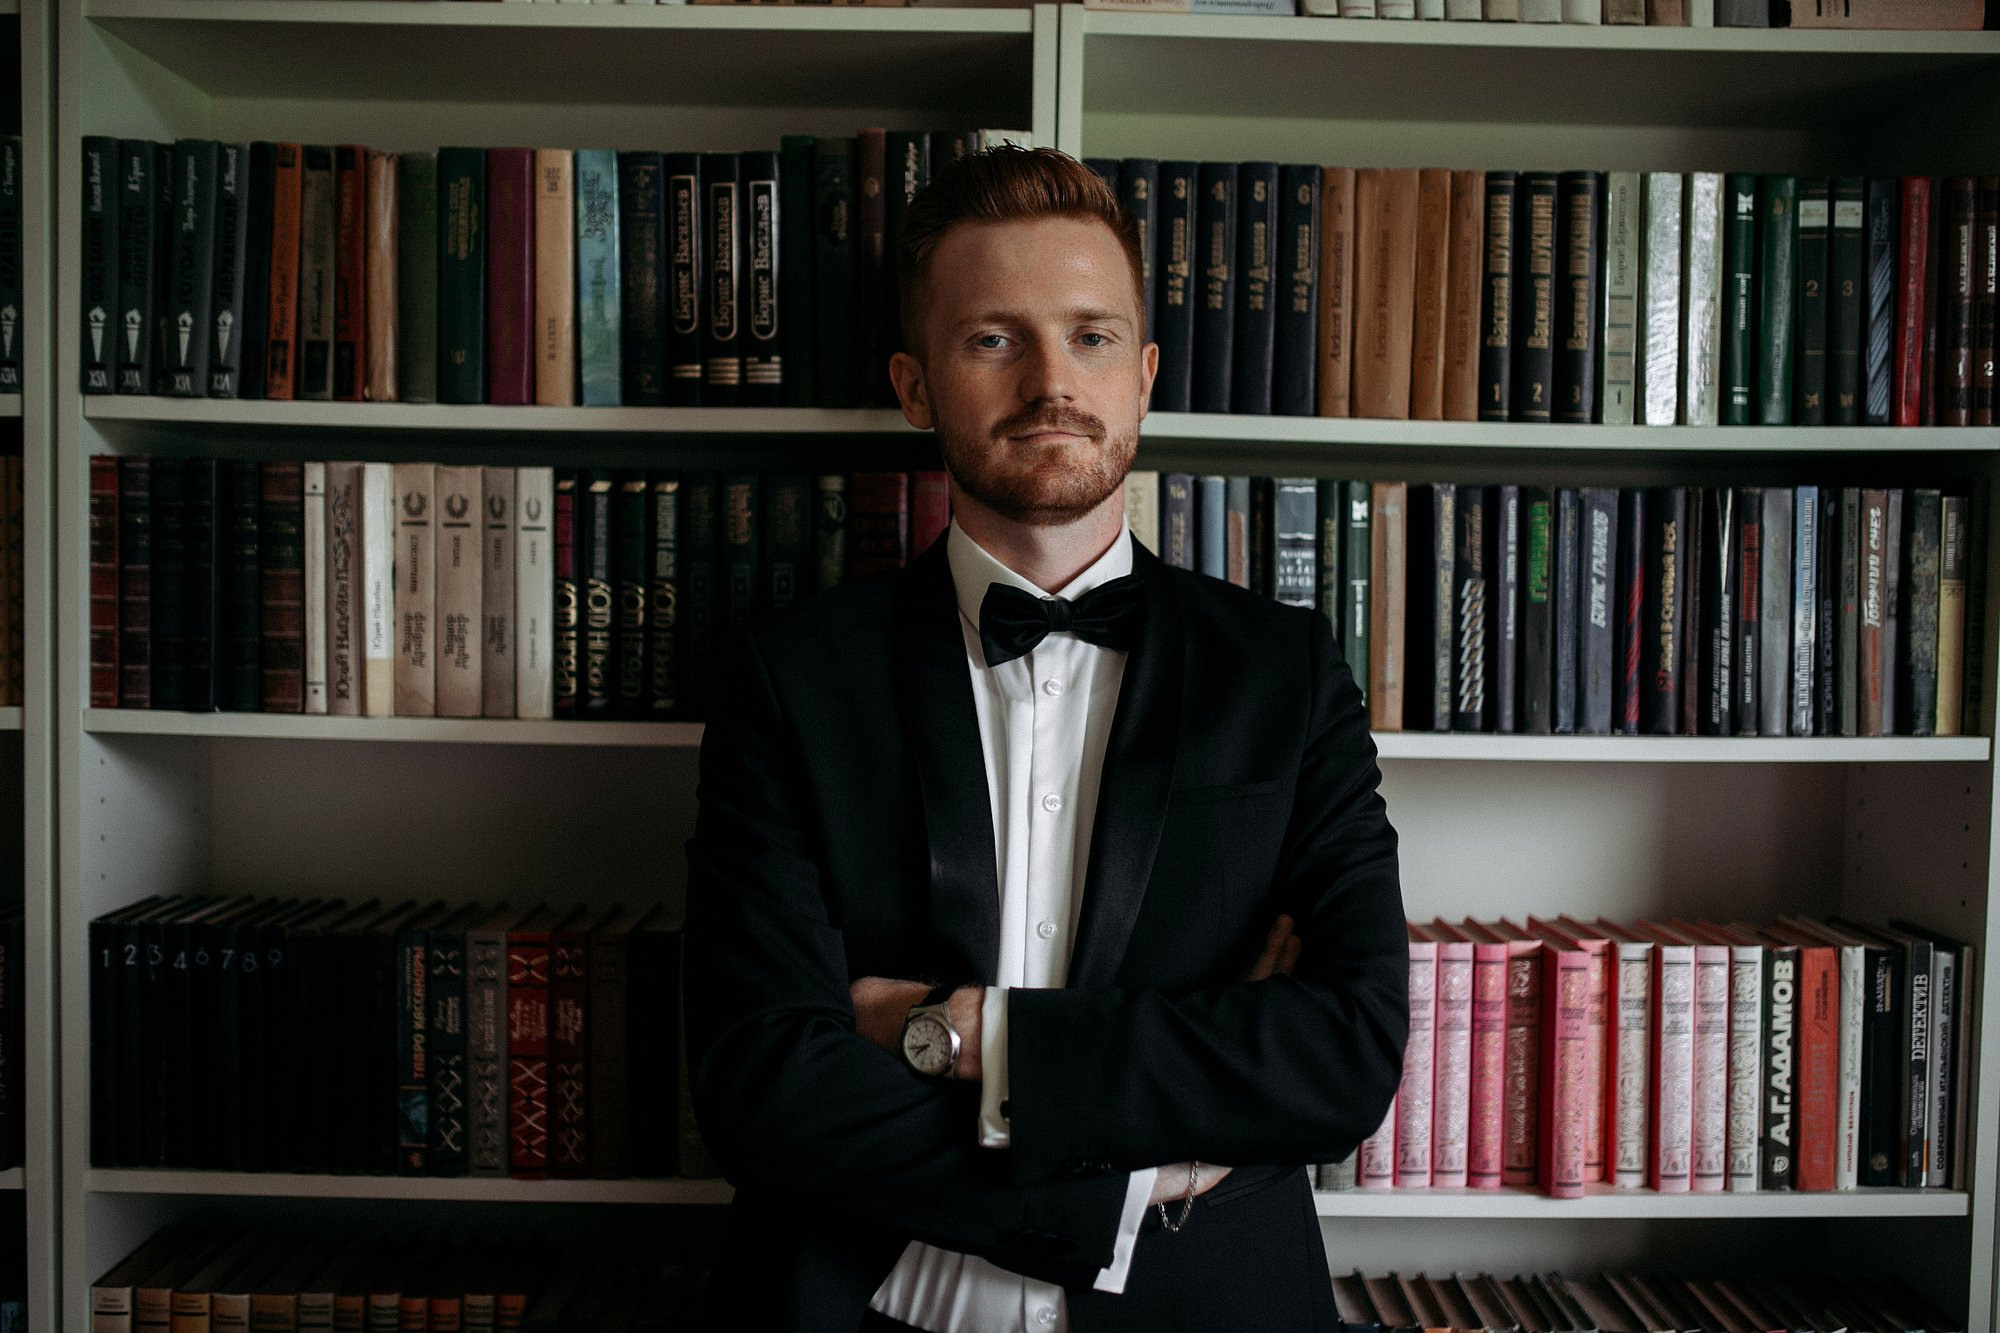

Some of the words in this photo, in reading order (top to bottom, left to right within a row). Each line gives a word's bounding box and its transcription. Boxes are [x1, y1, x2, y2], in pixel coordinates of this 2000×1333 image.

[1173, 177, 1187, 200] 3
[1298, 183, 1310, 206] 6
[674, 188, 690, 264] Васильев
[715, 196, 729, 272] Васильев
[754, 194, 769, 270] Васильев
[1489, 194, 1510, 273] ШУКШИН
[1530, 194, 1553, 274] ШУКШИН
[1568, 194, 1591, 276] ШУКШИН
[677, 270, 694, 320] Борис
[715, 275, 733, 327] Борис
[755, 274, 773, 326] Борис
[1487, 277, 1509, 347] Василий
[1805, 279, 1819, 297] 2
[1841, 279, 1854, 297] 3
[1527, 279, 1550, 348] Василий
[1567, 279, 1589, 350] Василий
[1494, 383, 1501, 402] 1
[1983, 360, 1994, 377] 2
[1532, 383, 1542, 403] 2
[1572, 384, 1581, 404] 3
[587, 578, 611, 627] ШОУ
[101, 949, 109, 968] 1
[124, 943, 136, 965] 2
[149, 943, 162, 965] 3
[173, 951, 186, 970] 4
[196, 947, 209, 966] 6
[221, 948, 234, 969] 7
[242, 953, 256, 973] 8
[268, 949, 282, 968] 9
[412, 945, 426, 1030] КАССАНДРЫ
[1941, 967, 1951, 1015] ДЕТЕКТИВ
[412, 1034, 425, 1080] ТАВРО
[1771, 960, 1793, 1146] А.Г.АДАМОВ
[1939, 1022, 1949, 1092] ИТАЛЬЯНСКИЙ
[1937, 1096, 1946, 1169] СОВРЕМЕННЫЙ
